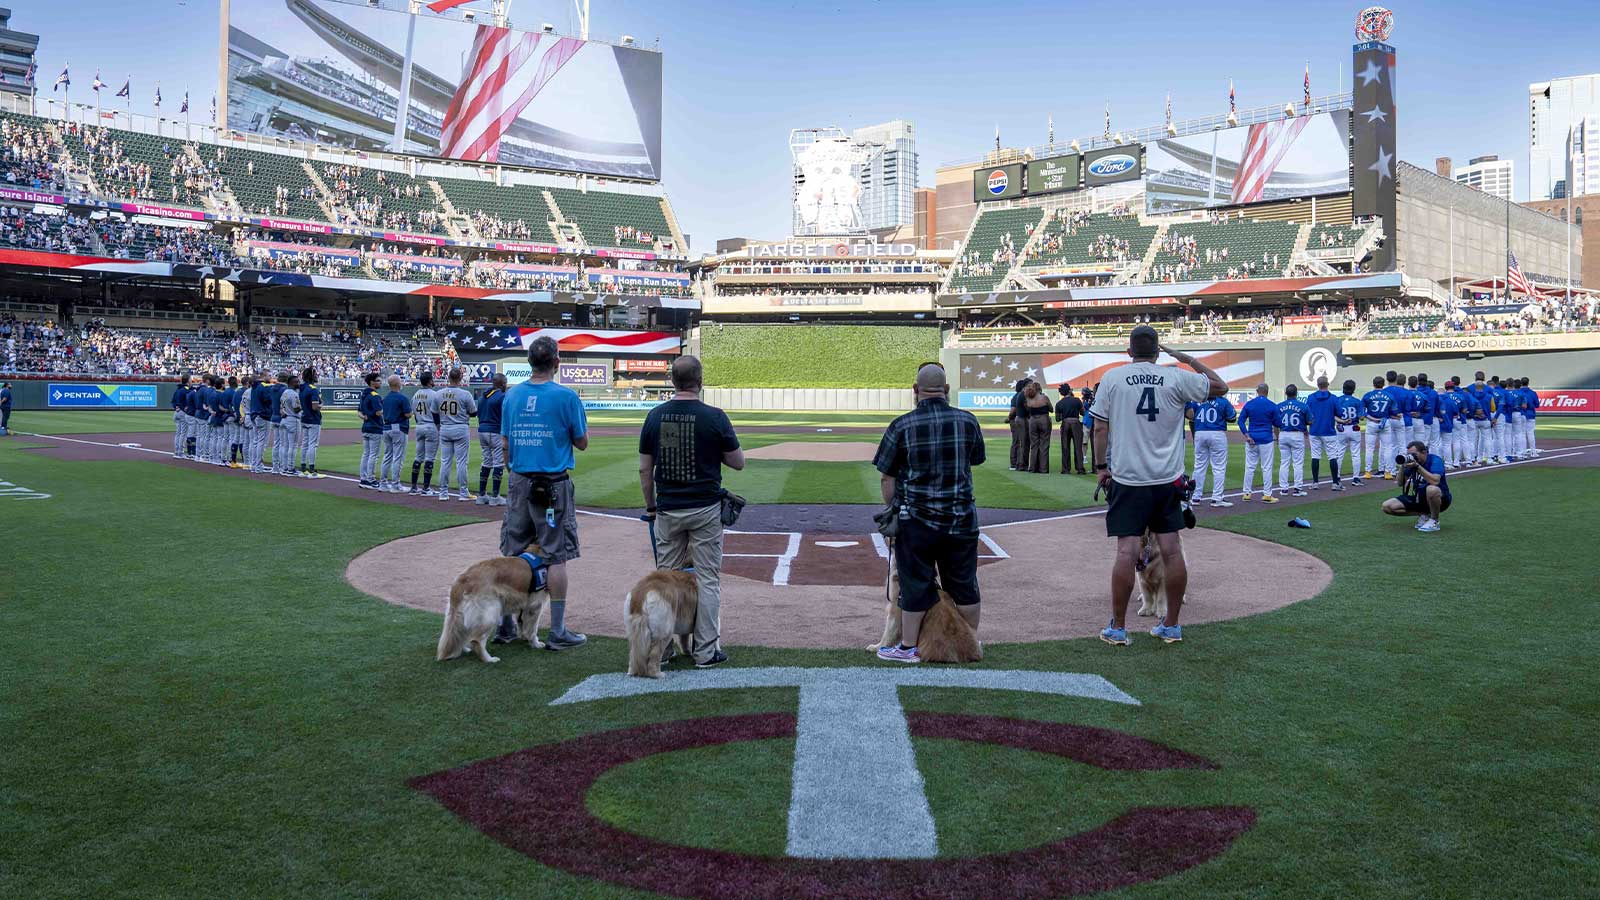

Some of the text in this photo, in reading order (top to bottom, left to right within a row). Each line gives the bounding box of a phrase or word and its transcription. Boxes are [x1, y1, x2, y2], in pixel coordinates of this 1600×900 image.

[1039, 166, 1067, 177] Minnesota
[1046, 161, 1056, 170] The
[1097, 158, 1126, 173] Ford
[989, 178, 1007, 186] PEPSI
[1043, 180, 1063, 189] Tribune
[1051, 174, 1064, 183] Star
[24, 192, 55, 204] Island
[269, 220, 326, 233] Treasure Island
[502, 243, 531, 252] Treasure
[748, 244, 916, 257] TARGET FIELD
[618, 276, 682, 287] Home Run Deck
[1064, 300, 1095, 308] UNIVERSAL
[1098, 299, 1119, 307] SPORTS
[1412, 337, 1548, 350] WINNEBAGO INDUSTRIES
[480, 364, 491, 378] 9
[505, 369, 533, 377] PROGR
[1126, 374, 1164, 387] CORREA
[416, 401, 427, 415] 41
[440, 400, 458, 416] 40
[1136, 387, 1160, 422] 4
[1371, 400, 1388, 412] 37
[660, 413, 697, 422] FREEDOM
[1196, 407, 1218, 423] 40
[1281, 412, 1300, 427] 46
[532, 429, 554, 438] HOME
[514, 438, 543, 447] TRAINER
